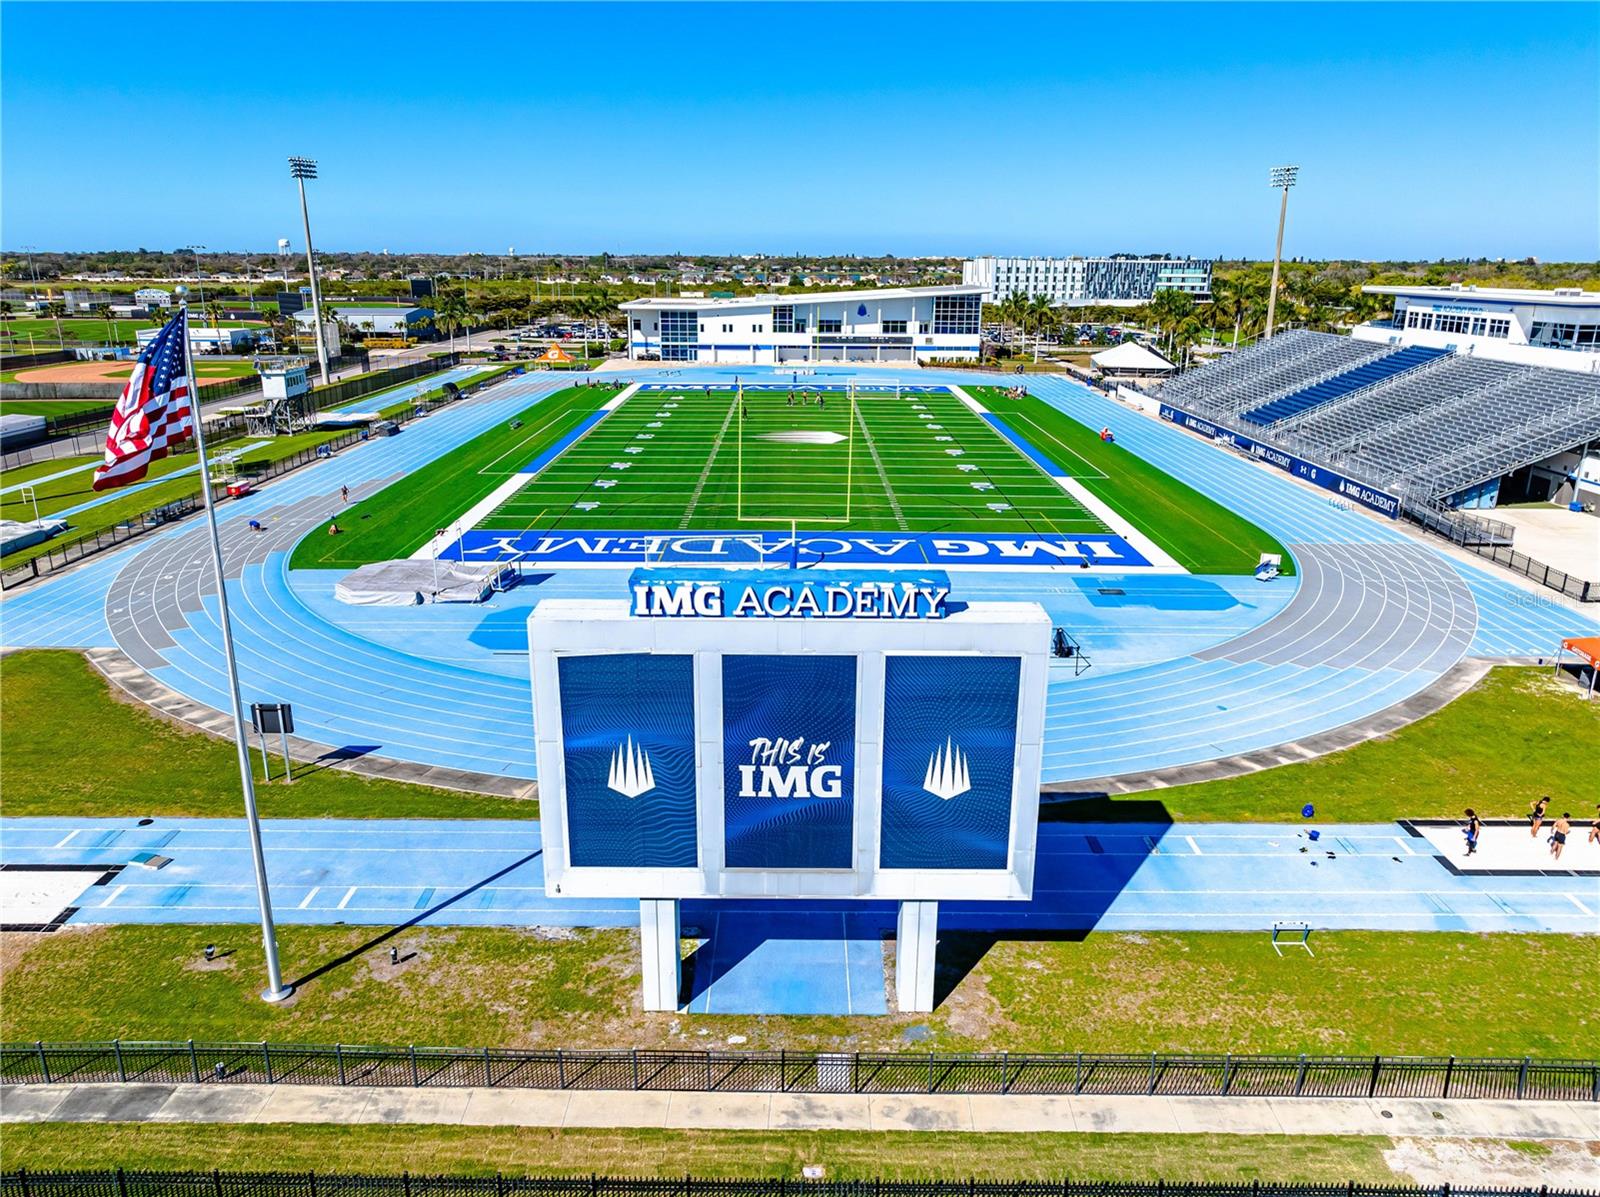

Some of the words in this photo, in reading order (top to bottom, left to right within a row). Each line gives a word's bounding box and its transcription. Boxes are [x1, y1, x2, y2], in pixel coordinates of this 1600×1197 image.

[1255, 445, 1266, 458] IMG
[1265, 449, 1291, 468] ACADEMY
[1346, 482, 1361, 498] IMG
[1360, 488, 1397, 513] ACADEMY
[930, 539, 1125, 560] IMG
[634, 586, 722, 616] IMG
[733, 586, 949, 618] ACADEMY
[749, 736, 804, 766] THIS
[807, 740, 831, 765] IS
[738, 764, 842, 798] IMG
